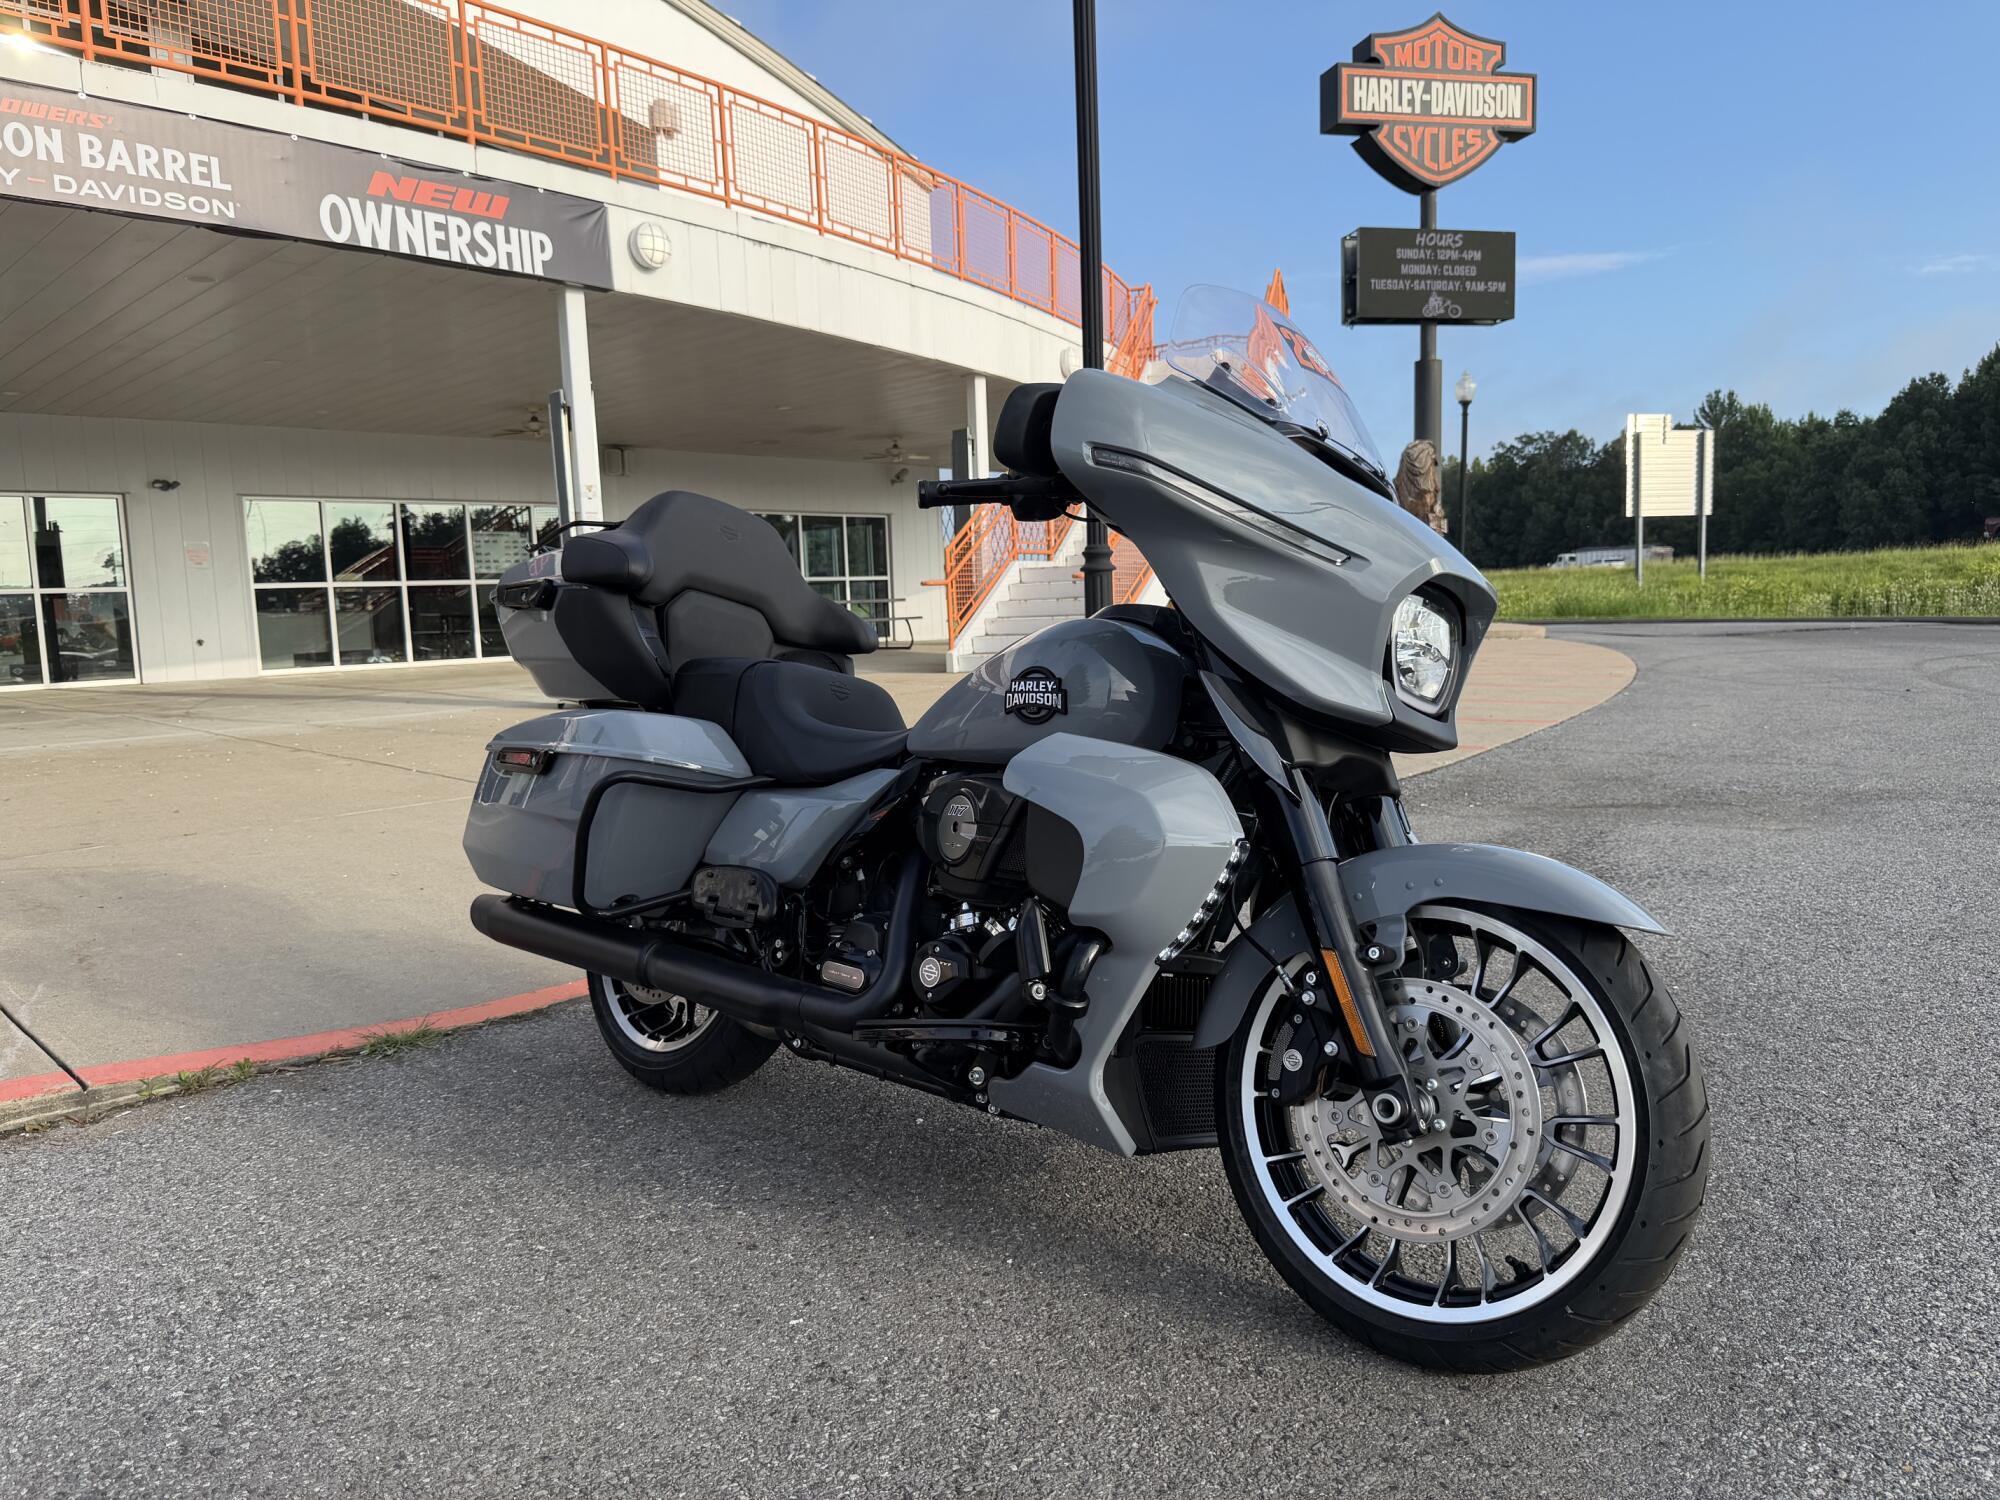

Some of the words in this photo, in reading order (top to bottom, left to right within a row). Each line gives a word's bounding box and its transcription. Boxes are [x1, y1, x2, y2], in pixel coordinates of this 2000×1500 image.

[1394, 31, 1483, 72] MOTOR
[1353, 76, 1522, 119] HARLEY-DAVIDSON
[0, 121, 64, 164] ON
[78, 132, 232, 191] BARREL
[1393, 125, 1482, 172] CYCLES
[366, 170, 511, 220] NEW
[319, 193, 554, 277] OWNERSHIP
[1415, 232, 1463, 249] HOURS
[1396, 248, 1435, 260] SUNDAY:
[1401, 264, 1441, 275] MONDAY:
[1443, 265, 1477, 277] CLOSED
[1011, 681, 1057, 692] HARLEY-
[1006, 693, 1062, 710] DAVIDSON
[947, 804, 970, 817] 117
